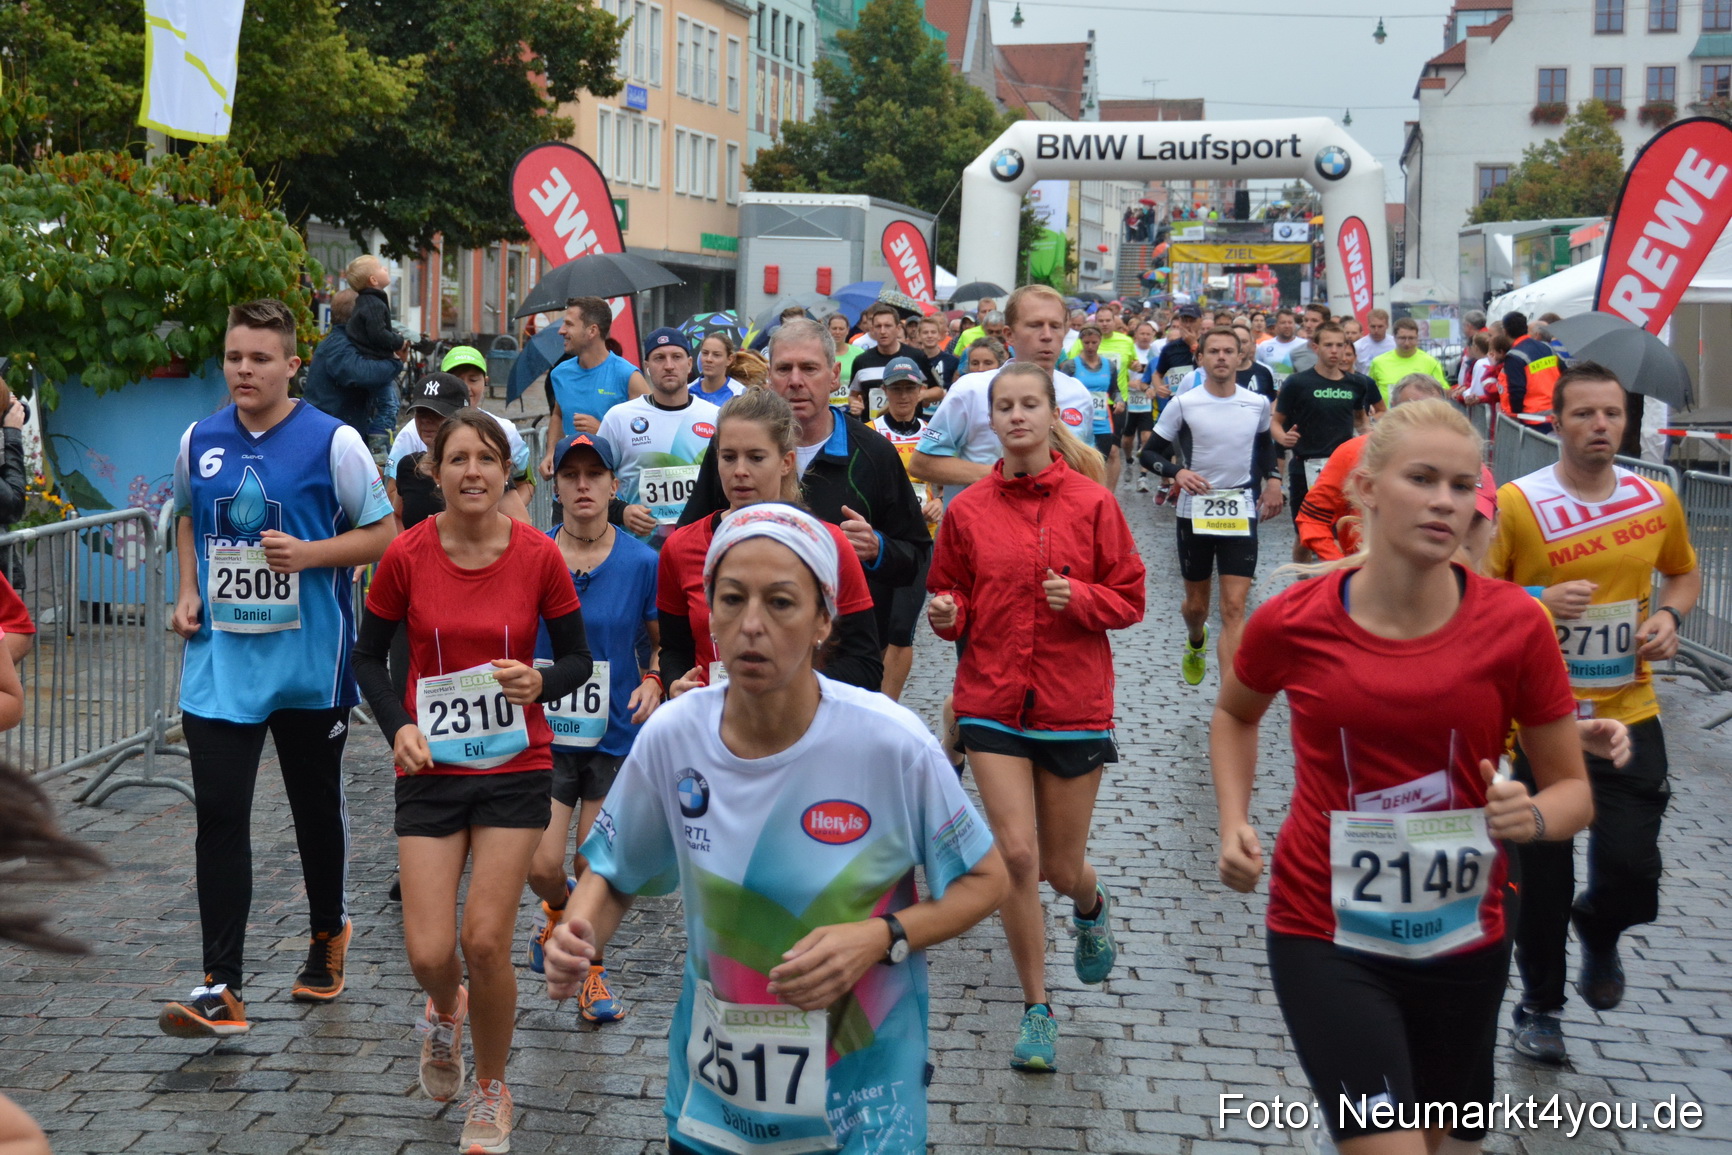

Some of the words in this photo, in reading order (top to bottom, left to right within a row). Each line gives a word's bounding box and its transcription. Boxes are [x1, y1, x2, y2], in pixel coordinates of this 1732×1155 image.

[1036, 134, 1128, 160] BMW
[1137, 133, 1301, 165] Laufsport
[1608, 147, 1729, 328] REWE
[1225, 247, 1257, 260] ZIEL
[423, 380, 440, 396] NY
[1313, 387, 1354, 400] adidas
[631, 435, 652, 443] PARTL
[199, 447, 225, 478] 6
[646, 480, 696, 503] 3109
[1204, 499, 1238, 516] 238
[1206, 521, 1236, 529] Andreas
[1548, 536, 1607, 567] MAX
[1612, 516, 1667, 546] BÖGL
[247, 549, 266, 560] BO
[217, 567, 291, 600] 2508
[234, 608, 272, 621] Daniel
[1556, 622, 1631, 655] 2710
[423, 685, 456, 695] NeuerMarkt
[460, 672, 499, 688] BOC
[429, 692, 514, 736] 2310
[465, 741, 485, 757] Evi
[674, 769, 708, 790] BMW
[1381, 788, 1423, 810] DEHN
[811, 811, 863, 834] Hervis
[1406, 815, 1472, 837] BOCK
[685, 826, 711, 842] RTL
[1344, 829, 1397, 839] NeuerMarkt
[688, 842, 710, 852] arkt
[1351, 846, 1482, 903] 2146
[1390, 918, 1443, 939] Elena
[725, 1009, 810, 1029] BOCK
[698, 1025, 810, 1105] 2517
[721, 1103, 781, 1139] Sabine
